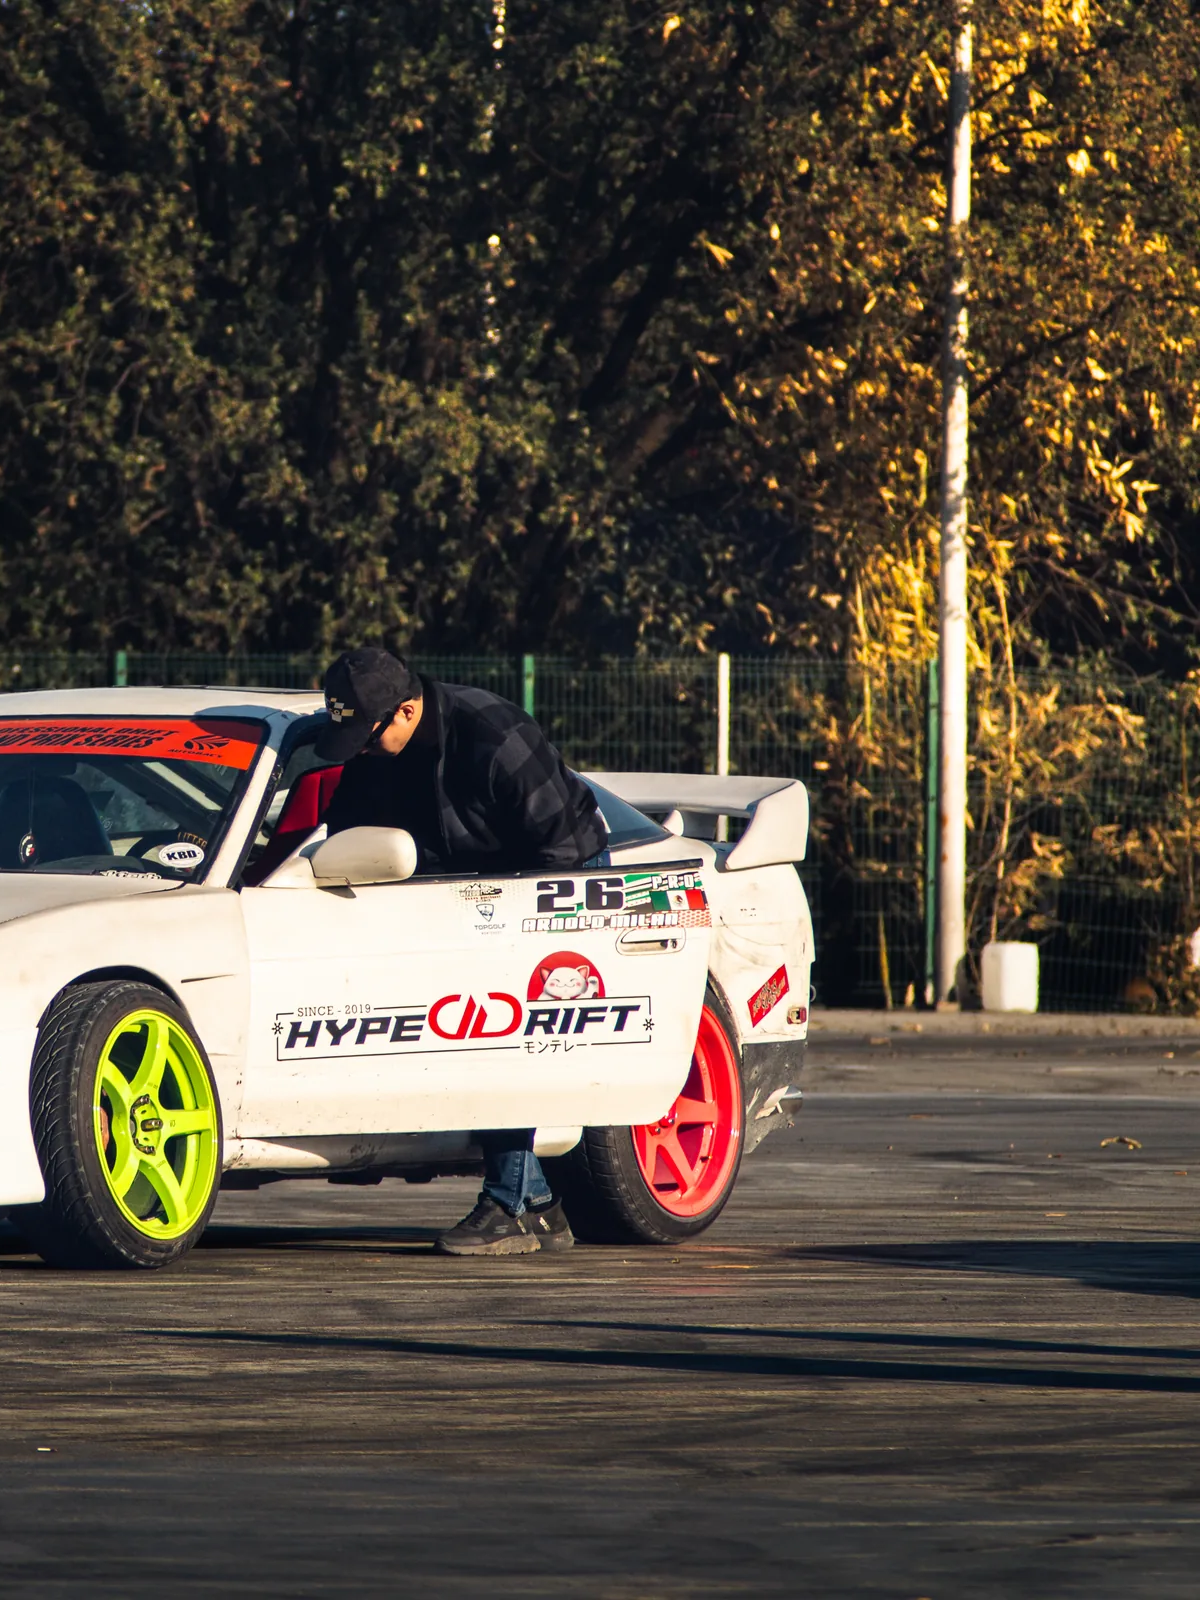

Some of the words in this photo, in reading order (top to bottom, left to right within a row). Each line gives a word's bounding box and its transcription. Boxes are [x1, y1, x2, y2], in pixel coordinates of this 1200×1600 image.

[113, 727, 179, 737] DRIFT
[16, 733, 86, 747] PRIX
[72, 735, 165, 749] SERIES
[165, 849, 198, 861] KBD
[536, 877, 624, 914] 26
[474, 923, 507, 931] TOPGOLF
[522, 915, 605, 933] ARNOLD
[609, 912, 679, 929] MILAN
[297, 1005, 334, 1017] SINCE
[344, 1004, 371, 1015] 2019
[285, 1014, 427, 1049] HYPE
[523, 1040, 588, 1054] モンテレー
